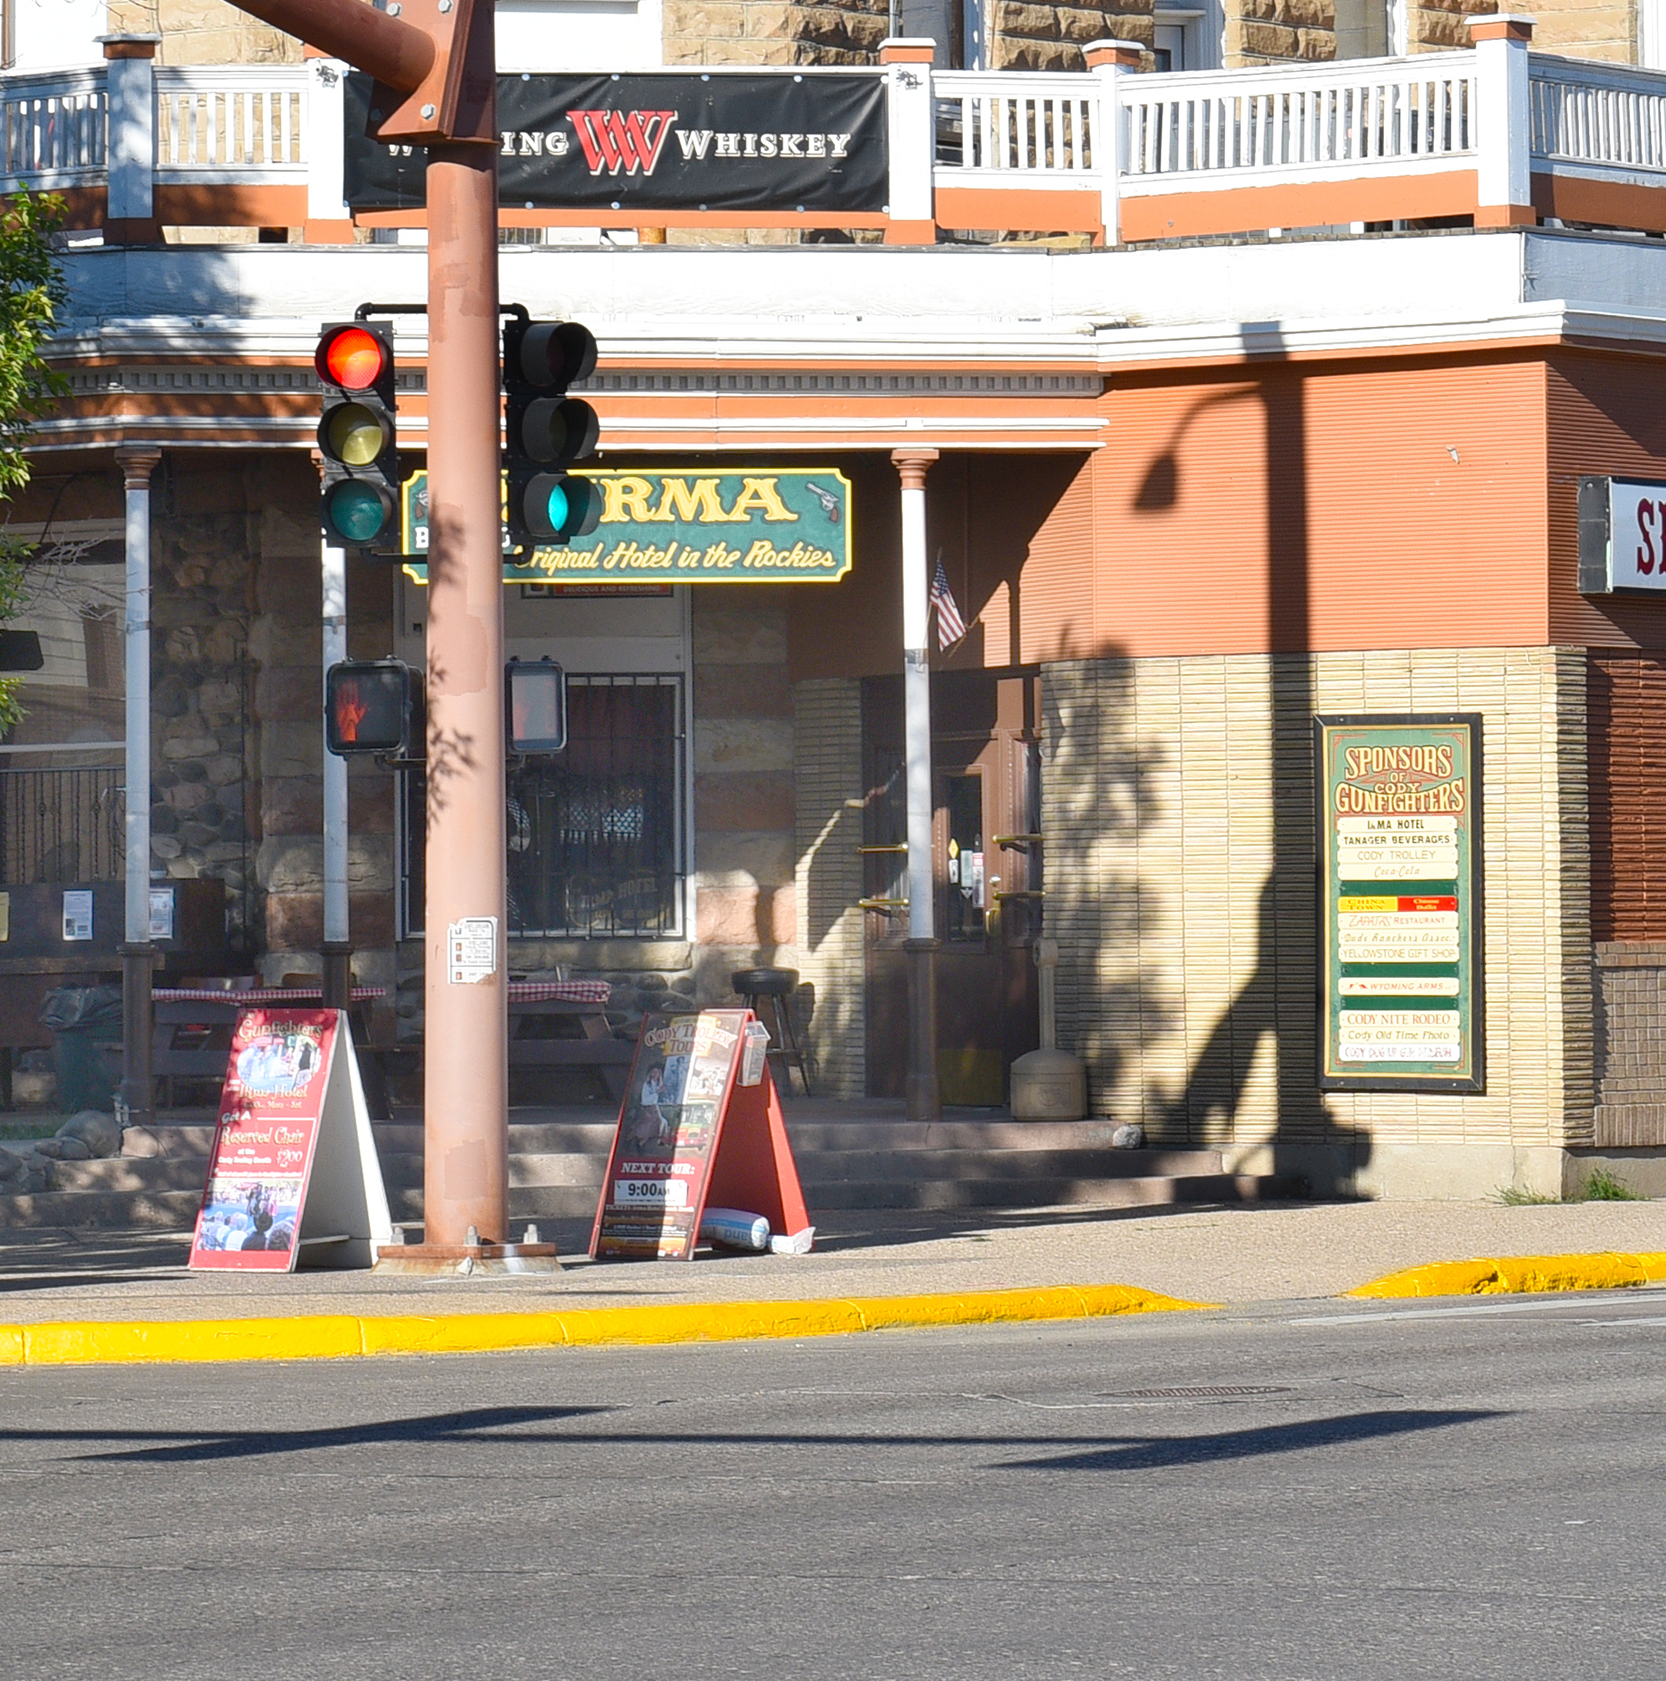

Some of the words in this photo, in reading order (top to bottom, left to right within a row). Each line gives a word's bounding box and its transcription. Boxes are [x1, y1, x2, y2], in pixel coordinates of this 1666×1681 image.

[674, 129, 851, 160] WHISKEY
[591, 478, 799, 523] RMA
[603, 540, 676, 569] Hotel
[677, 544, 699, 569] in
[700, 540, 740, 569] the
[742, 541, 837, 569] Rockies
[1345, 745, 1452, 780] SPONSORS
[1390, 772, 1408, 783] OF
[1374, 782, 1421, 794] CODY
[1335, 777, 1466, 813] GUNFIGHTERS
[1397, 819, 1425, 829] HOTEL
[1343, 836, 1387, 845] TANAGER
[1391, 835, 1451, 845] BEVERAGES
[1357, 850, 1384, 860] CODY
[1389, 850, 1436, 860] TROLLEY
[1343, 948, 1405, 958] YELLOWSTONE
[1408, 948, 1429, 958] GIFT
[1432, 948, 1456, 958] SHOP
[1370, 982, 1415, 991] WYOMING
[1417, 982, 1444, 991] ARMS
[1347, 1013, 1378, 1025] CODY
[1380, 1013, 1409, 1025] NITE
[1412, 1013, 1451, 1025] RODEO
[645, 1026, 681, 1047] CODY
[1348, 1030, 1371, 1042] Cody
[1376, 1030, 1392, 1040] Old
[1395, 1030, 1419, 1040] Time
[1422, 1030, 1450, 1040] Photo
[669, 1039, 709, 1053] TOURS
[220, 1126, 273, 1147] Reserved
[274, 1126, 305, 1145] Chair
[621, 1161, 656, 1174] NEXT
[657, 1162, 696, 1175] TOUR:
